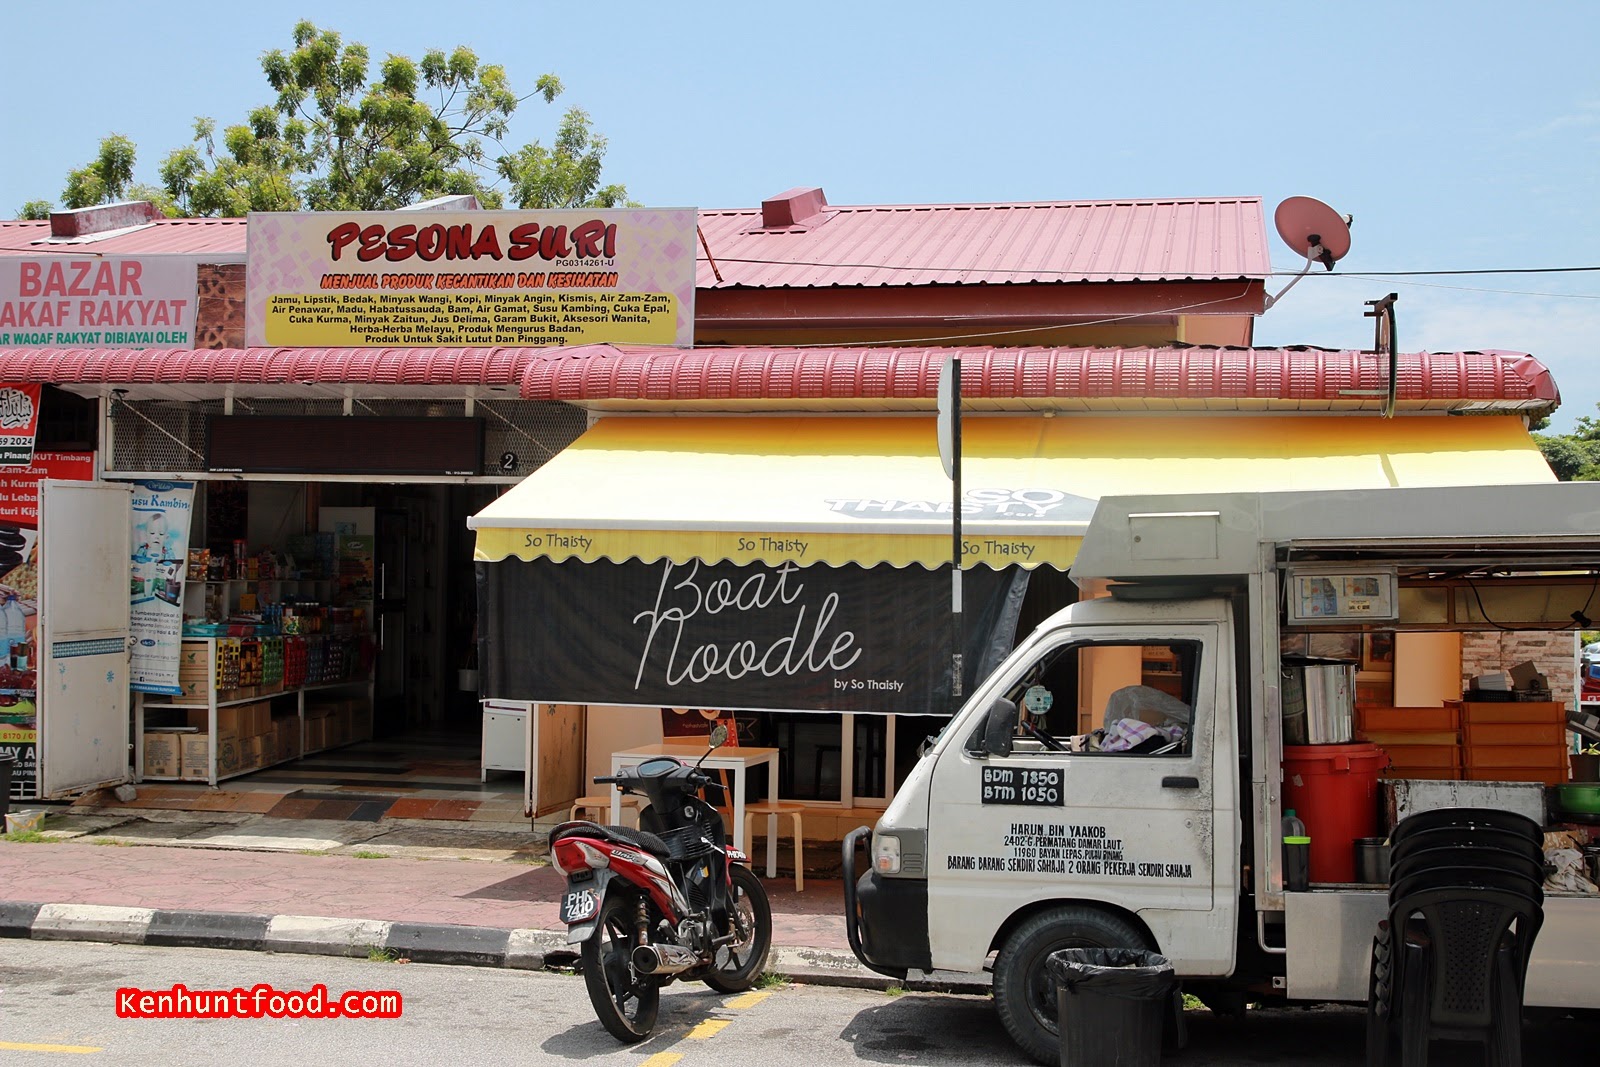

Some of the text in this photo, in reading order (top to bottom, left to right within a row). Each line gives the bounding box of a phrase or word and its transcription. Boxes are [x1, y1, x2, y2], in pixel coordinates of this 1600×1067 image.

[326, 219, 617, 262] PESONA SURI
[555, 259, 614, 267] PG0314261-U
[19, 260, 143, 297] BAZAR
[320, 271, 618, 289] MENJUAL PRODUK KECANTIKAN DAN KESIHATAN
[271, 294, 671, 305] Jamu, Lipstik, Bedak, Minyak Wangi, Kopi, Minyak Angin, Kismis, Air Zam-Zam,
[78, 299, 187, 327] RAKYAT
[272, 304, 670, 314] Air Penawar, Madu, Habatussauda, Bam, Air Gamat, Susu Kambing, Cuka Epal,
[289, 314, 651, 325] Cuka Kurma, Minyak Zaitun, Jus Delima, Garam Bukit, Aksesori Wanita,
[349, 325, 584, 335] Herba-Herba Melayu, Produk Mengurus Badan,
[13, 333, 53, 345] WAQAF
[56, 332, 101, 344] RAKYAT
[104, 332, 154, 344] DIBIAYAI
[155, 332, 187, 343] OLEH
[365, 335, 568, 345] Produk Untuk Sakit Lutut Dan Pinggang.
[10, 438, 33, 446] 2024
[4, 451, 31, 461] Pinang
[55, 453, 91, 464] Timbang
[503, 453, 515, 469] 2
[0, 466, 48, 474] Zam-Zam
[525, 533, 593, 553] So Thaisty
[737, 537, 808, 557] So Thaisty
[961, 540, 1036, 560] So Thaisty
[653, 556, 804, 624] Boat
[833, 678, 904, 692] by So Thaisty
[2, 732, 21, 740] 8170
[1021, 771, 1059, 786] 1850
[1021, 786, 1058, 803] 1050
[1011, 824, 1106, 838] HARUN BIN YAAKOB
[1035, 836, 1076, 849] PERMATANG
[1078, 838, 1102, 849] DAMAR
[1014, 848, 1036, 858] 11960
[1039, 848, 1060, 859] BAYAN
[947, 855, 1192, 878] BARANG BARANG SENDIRI SAHAJA 2 ORANG PEKERJA SENDIRI SAHAJA
[565, 900, 593, 917] 7410
